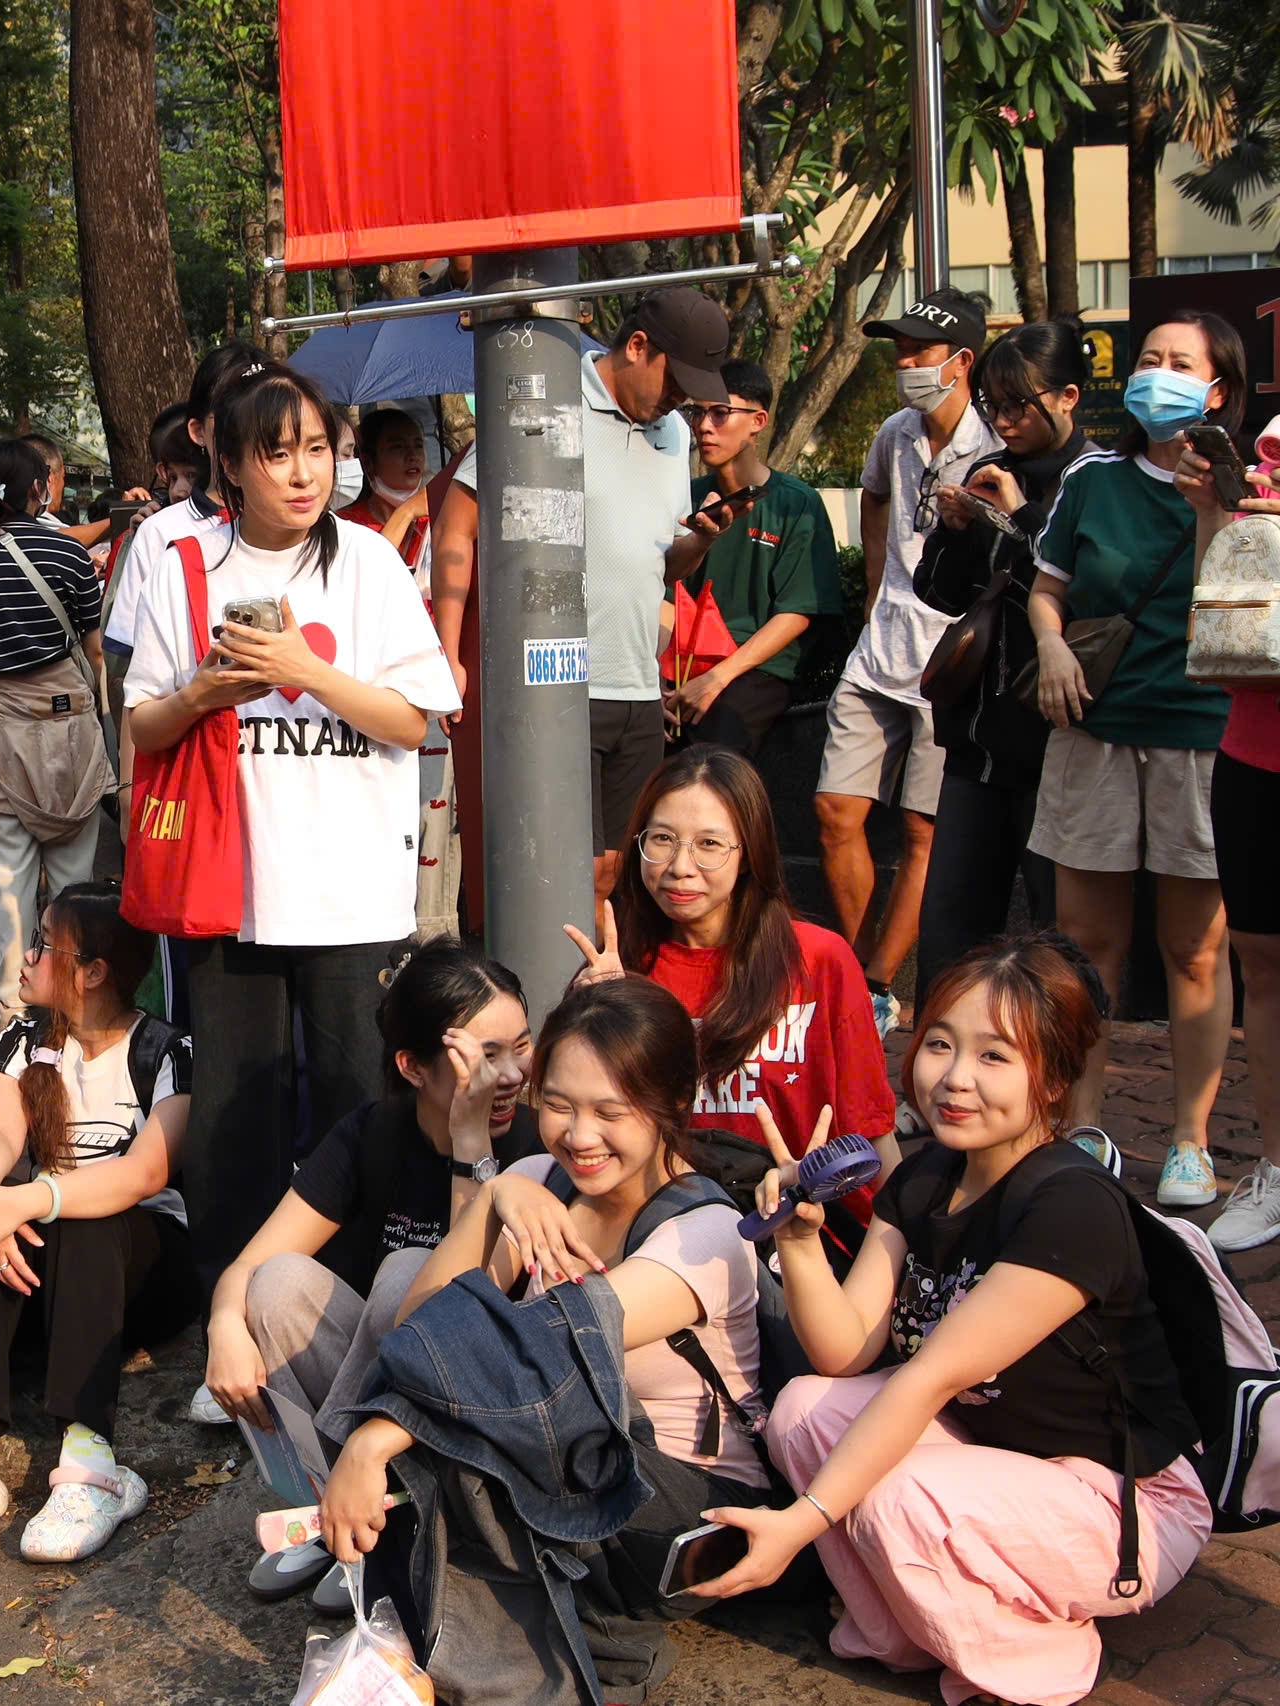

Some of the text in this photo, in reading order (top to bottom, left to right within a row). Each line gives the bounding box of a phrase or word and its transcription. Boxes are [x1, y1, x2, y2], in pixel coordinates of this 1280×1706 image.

[906, 302, 959, 328] ORT
[388, 1213, 441, 1231] oving you is
